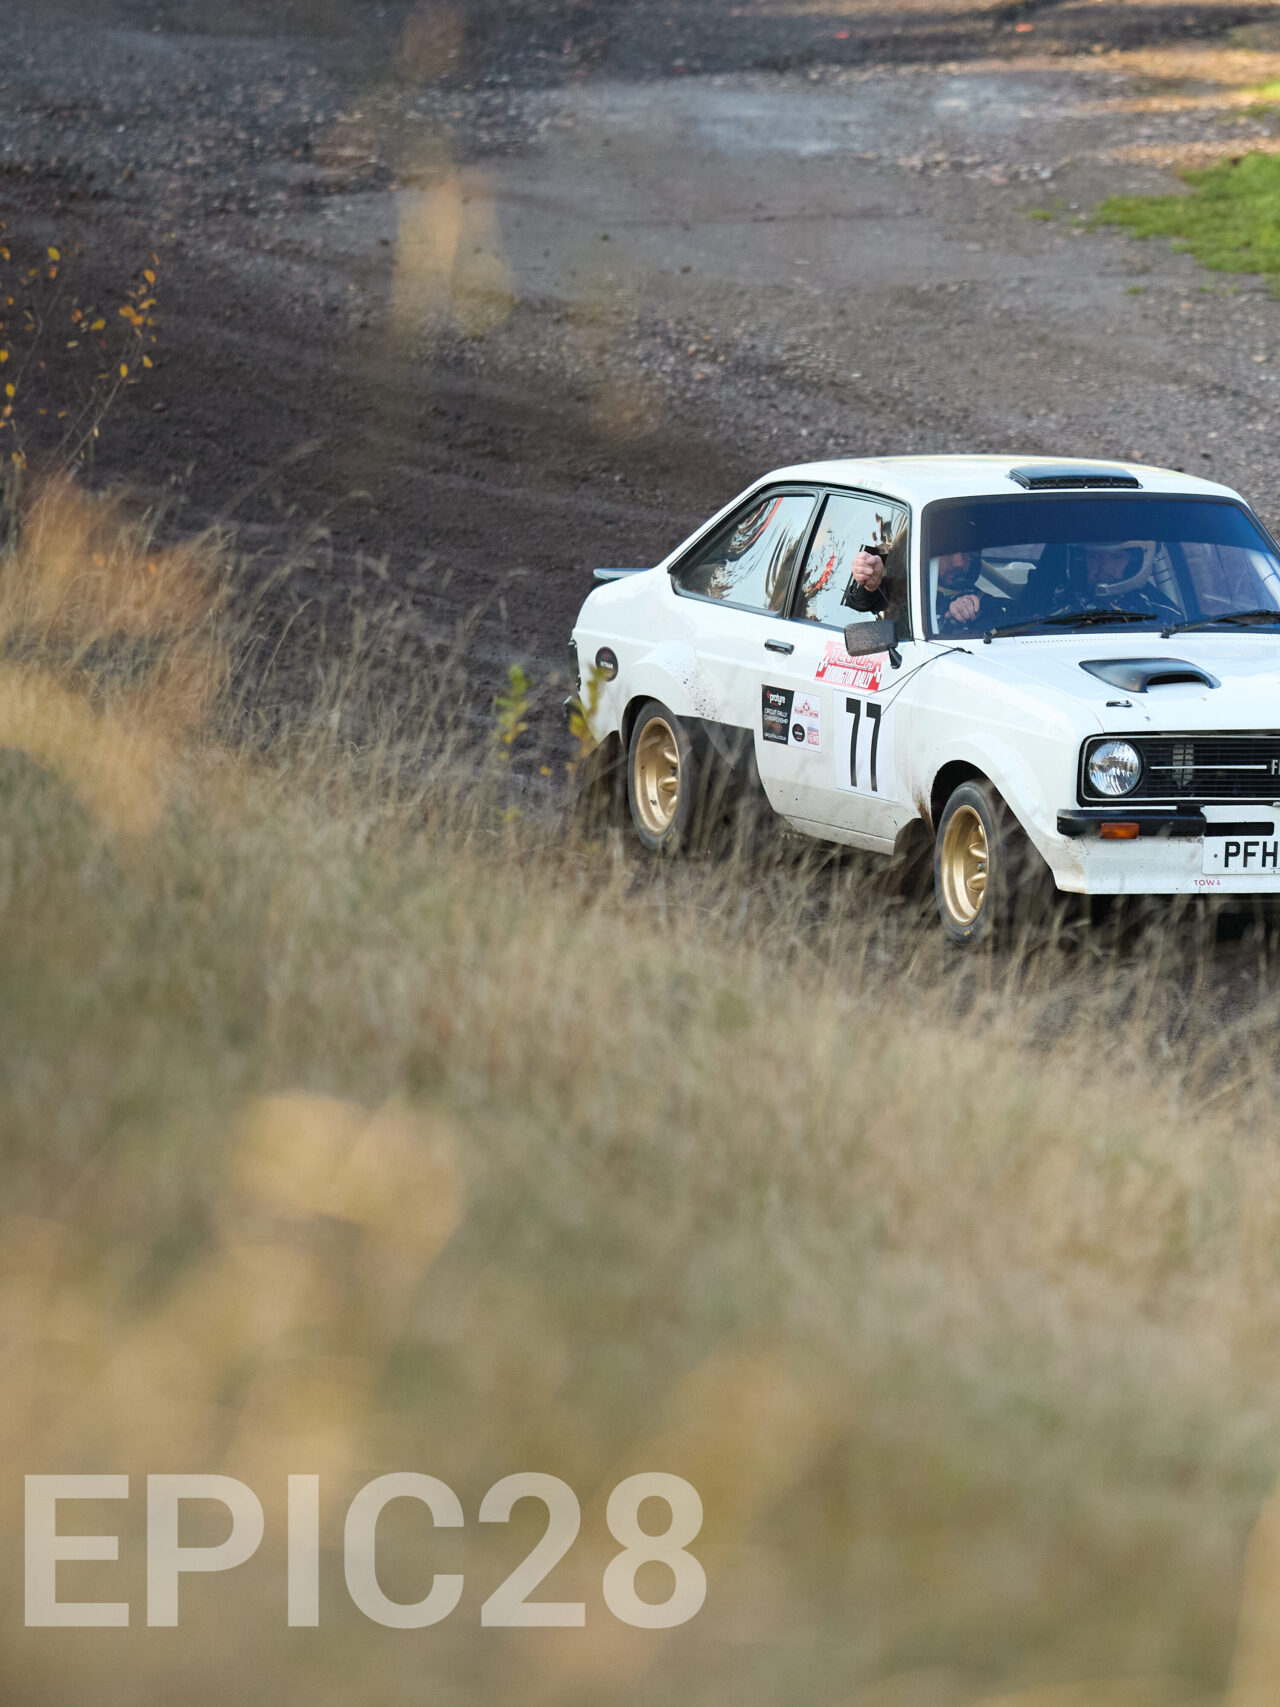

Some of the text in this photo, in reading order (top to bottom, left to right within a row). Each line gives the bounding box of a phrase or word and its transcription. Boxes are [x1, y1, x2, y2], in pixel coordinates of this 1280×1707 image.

[846, 697, 881, 792] 77
[1224, 841, 1278, 868] PFH
[1193, 879, 1215, 887] TOW
